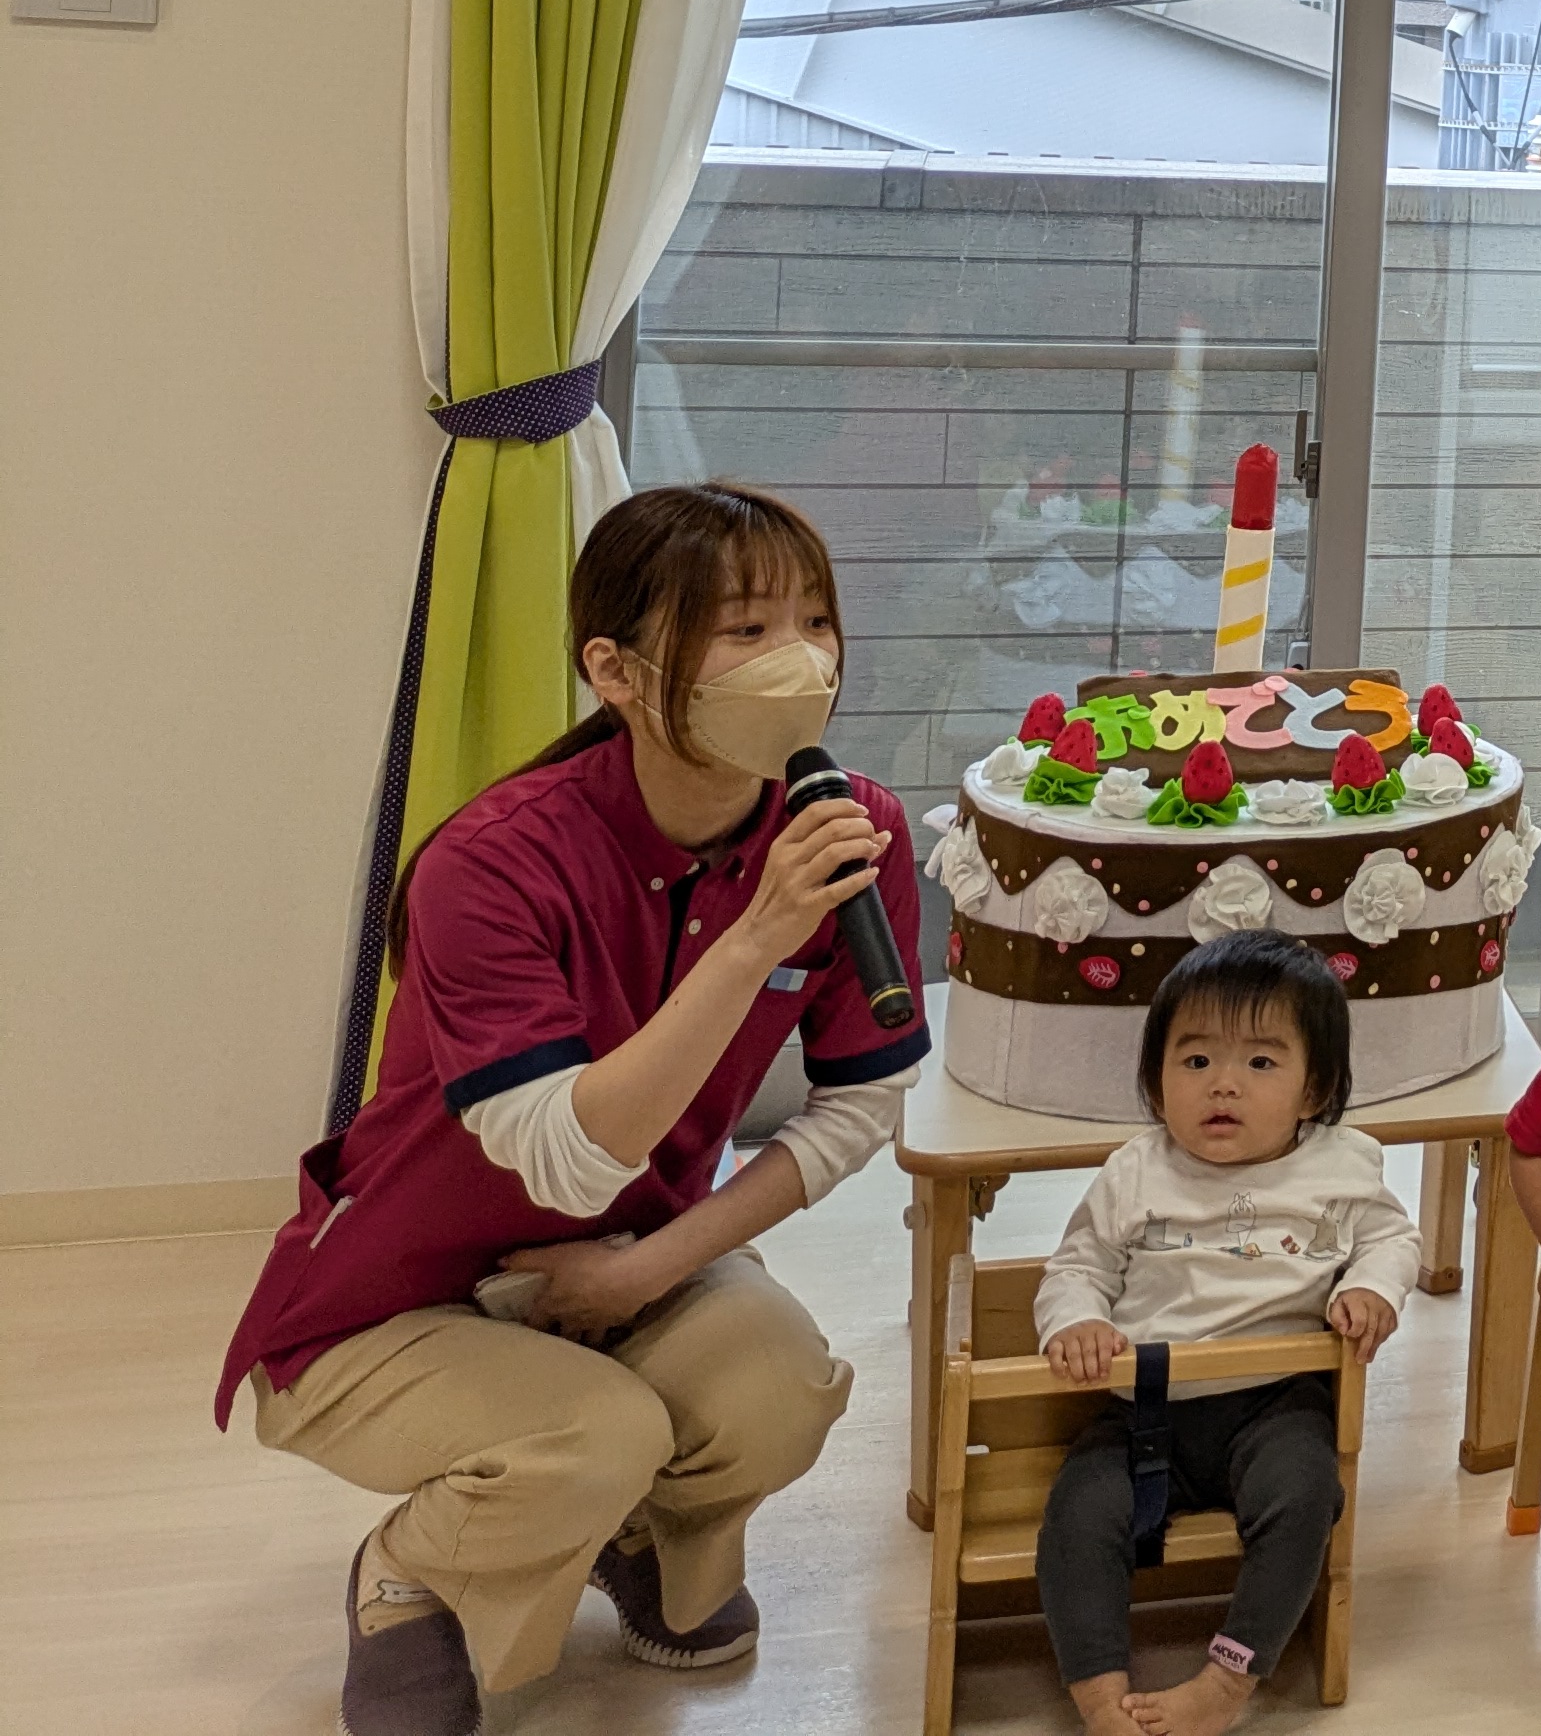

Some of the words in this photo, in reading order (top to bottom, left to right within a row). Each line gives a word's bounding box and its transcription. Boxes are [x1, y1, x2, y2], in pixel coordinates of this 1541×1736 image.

[1063, 675, 1413, 761] おめでとう
